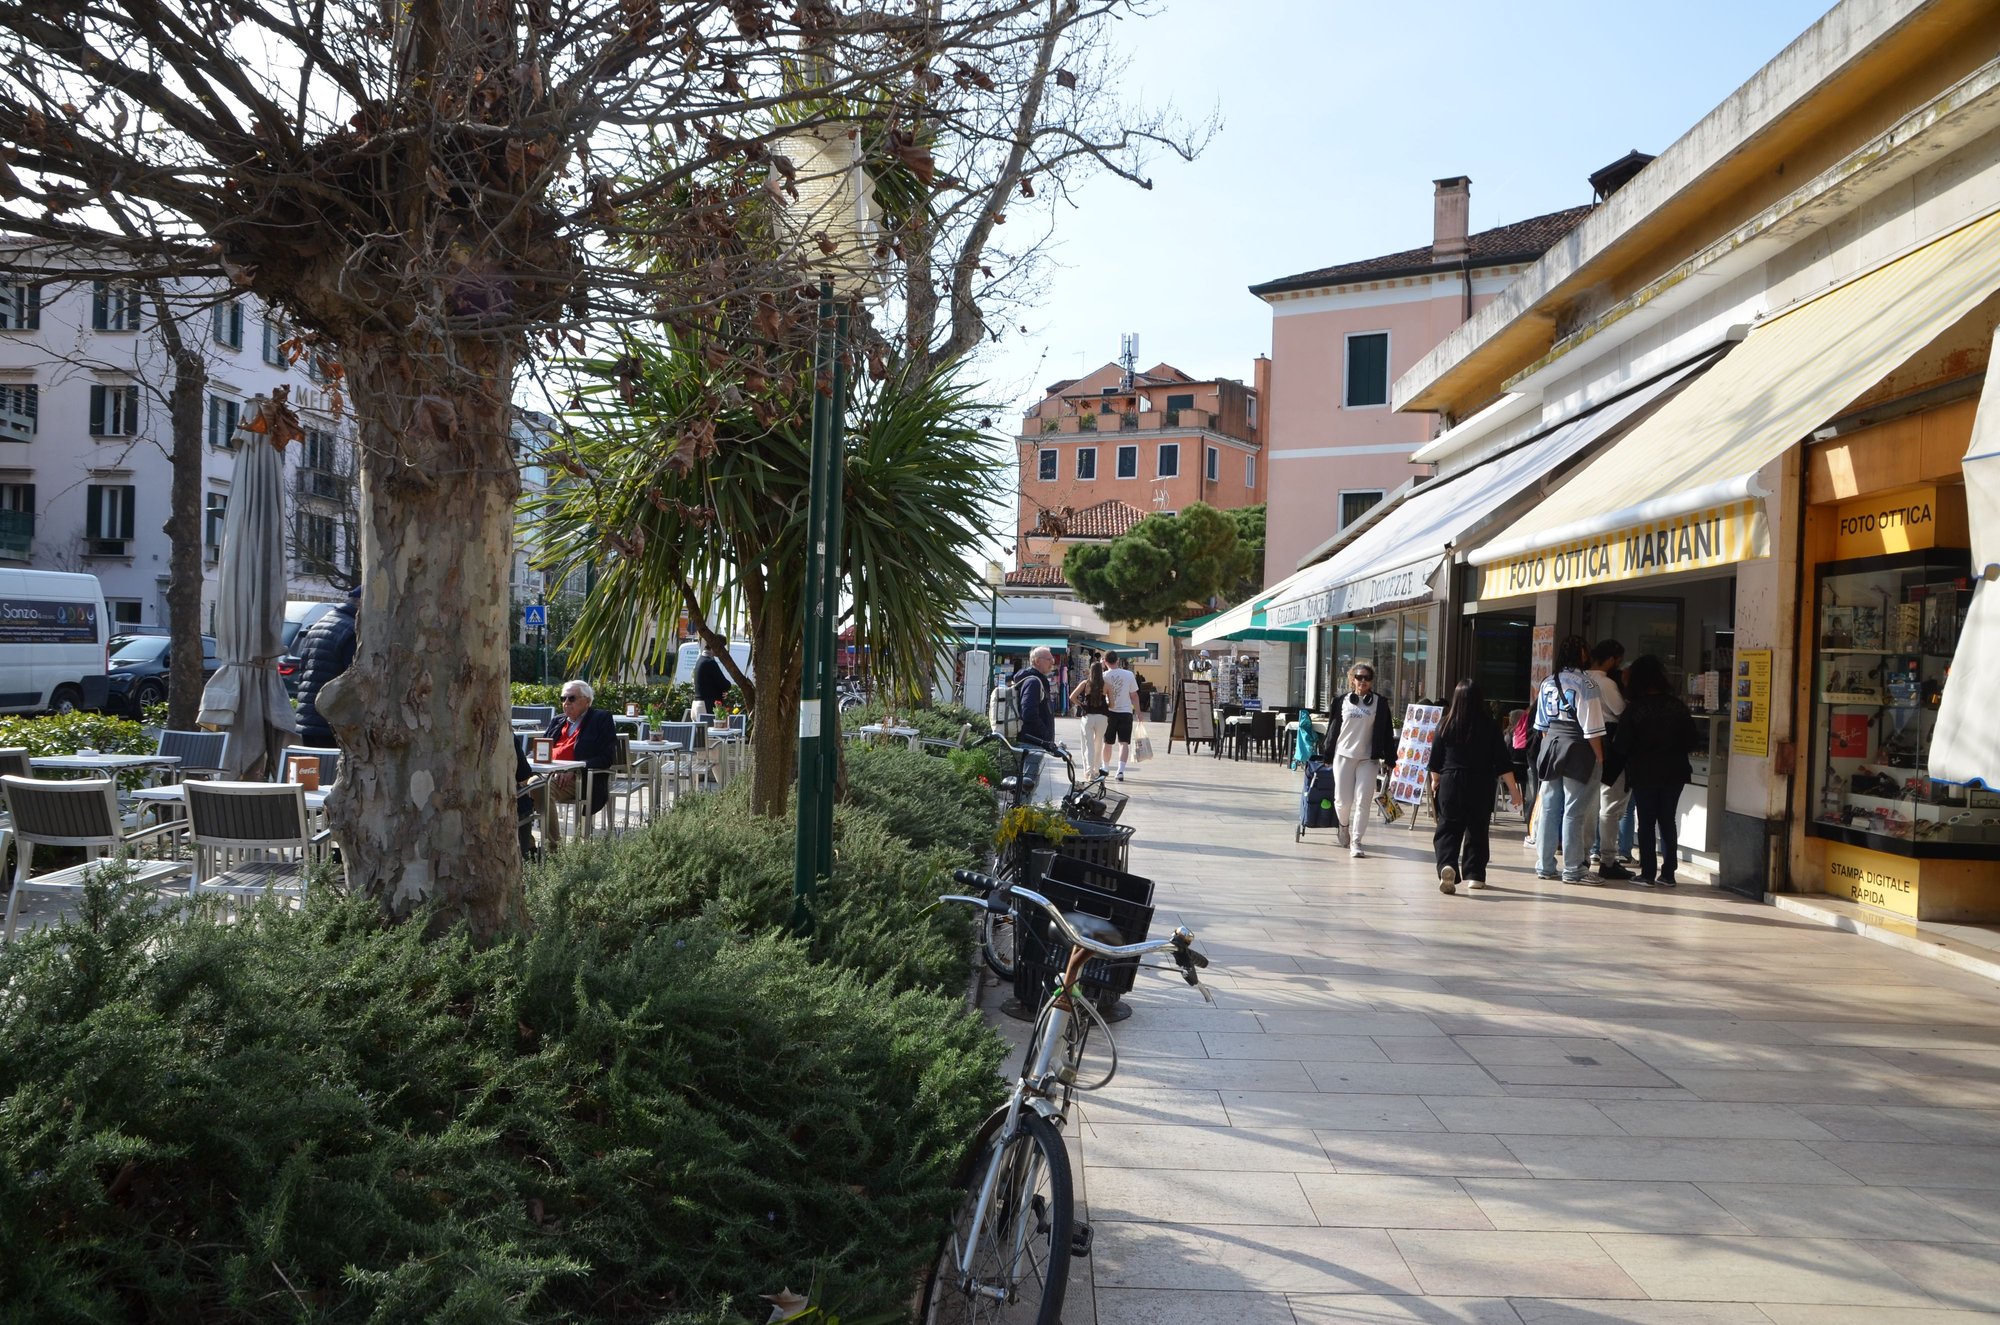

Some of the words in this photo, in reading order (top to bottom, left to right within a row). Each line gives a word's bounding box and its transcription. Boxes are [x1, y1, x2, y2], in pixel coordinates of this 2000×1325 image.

[1840, 513, 1875, 536] FOTO
[1878, 503, 1932, 529] OTTICA
[1509, 556, 1545, 590] FOTO
[1553, 543, 1610, 583] OTTICA
[1623, 517, 1721, 571] MARIANI
[1831, 862, 1865, 882] STAMPA
[1866, 871, 1911, 893] DIGITALE
[1851, 886, 1885, 906] RAPIDA
